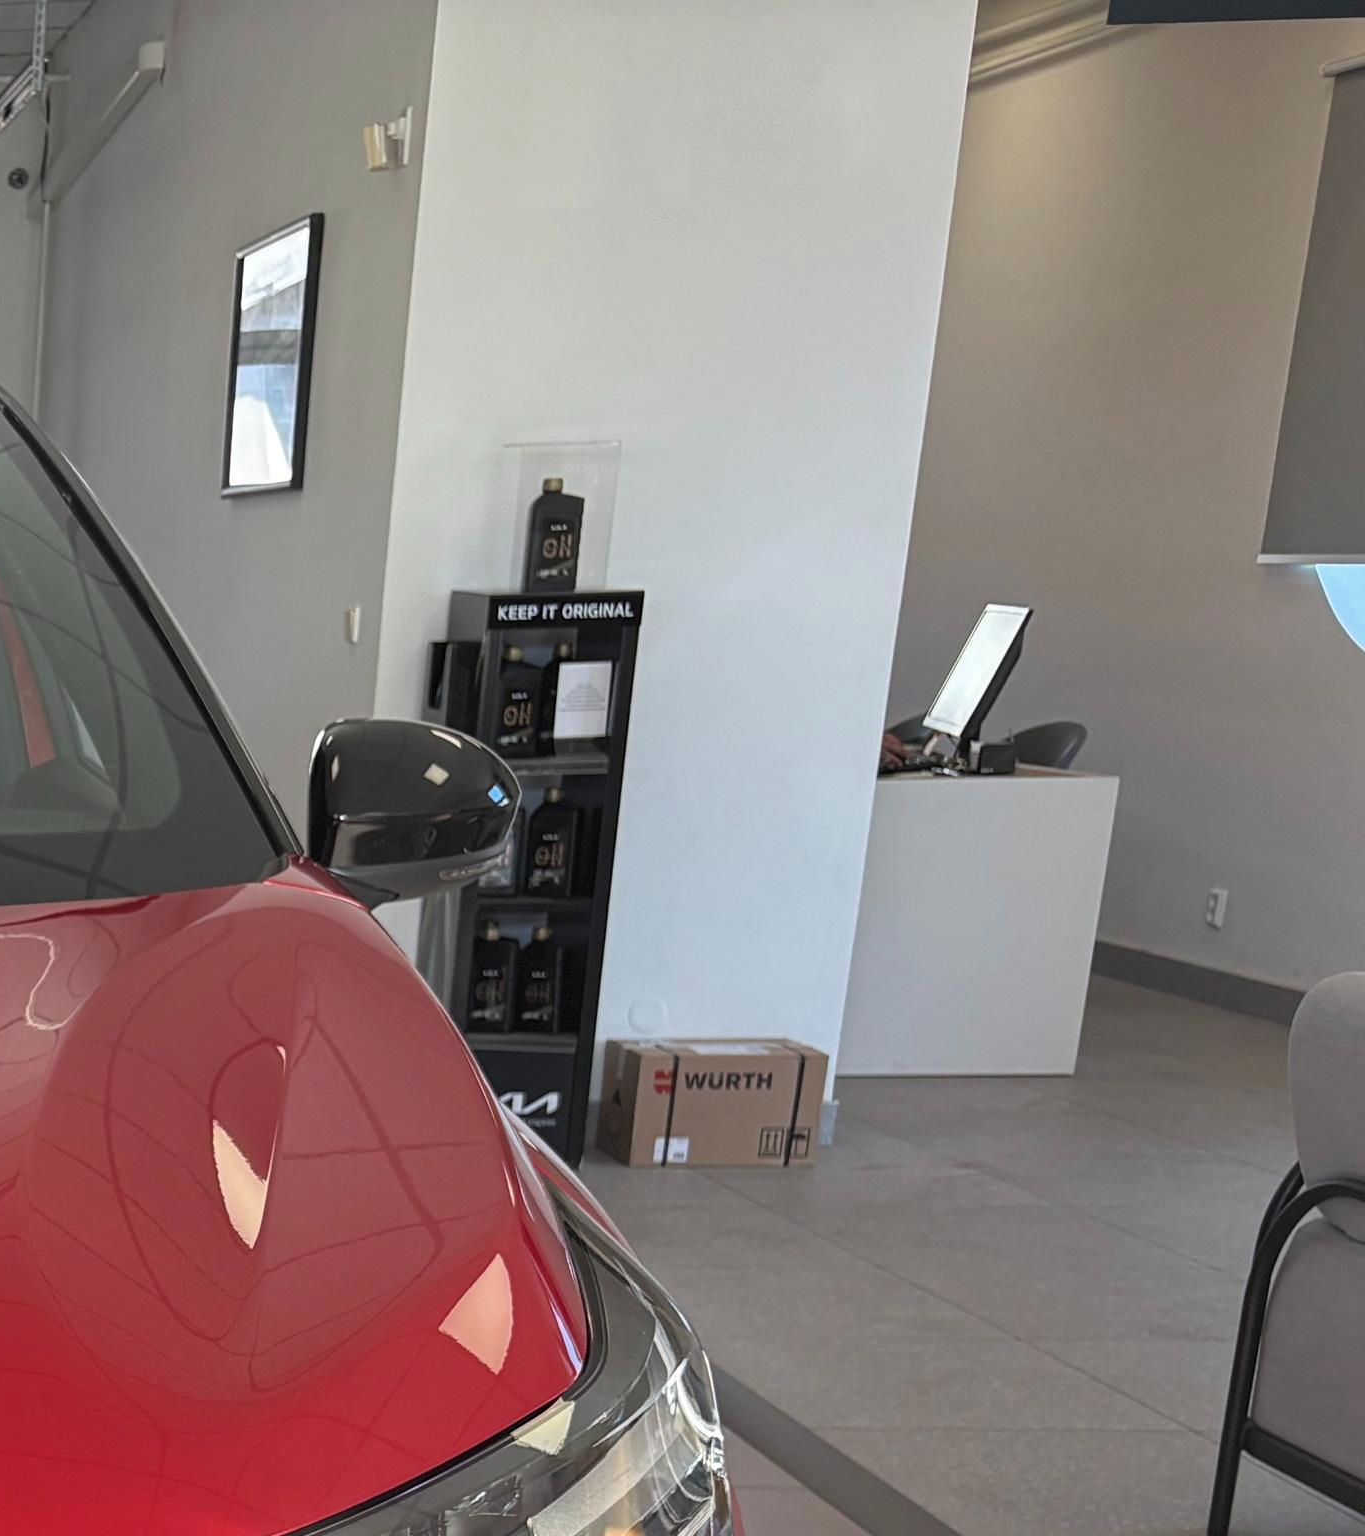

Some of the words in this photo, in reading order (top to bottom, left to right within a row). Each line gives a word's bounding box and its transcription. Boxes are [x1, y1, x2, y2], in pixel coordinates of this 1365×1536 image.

[497, 603, 540, 622] KEEP
[541, 603, 559, 620] IT
[561, 601, 635, 620] ORIGINAL
